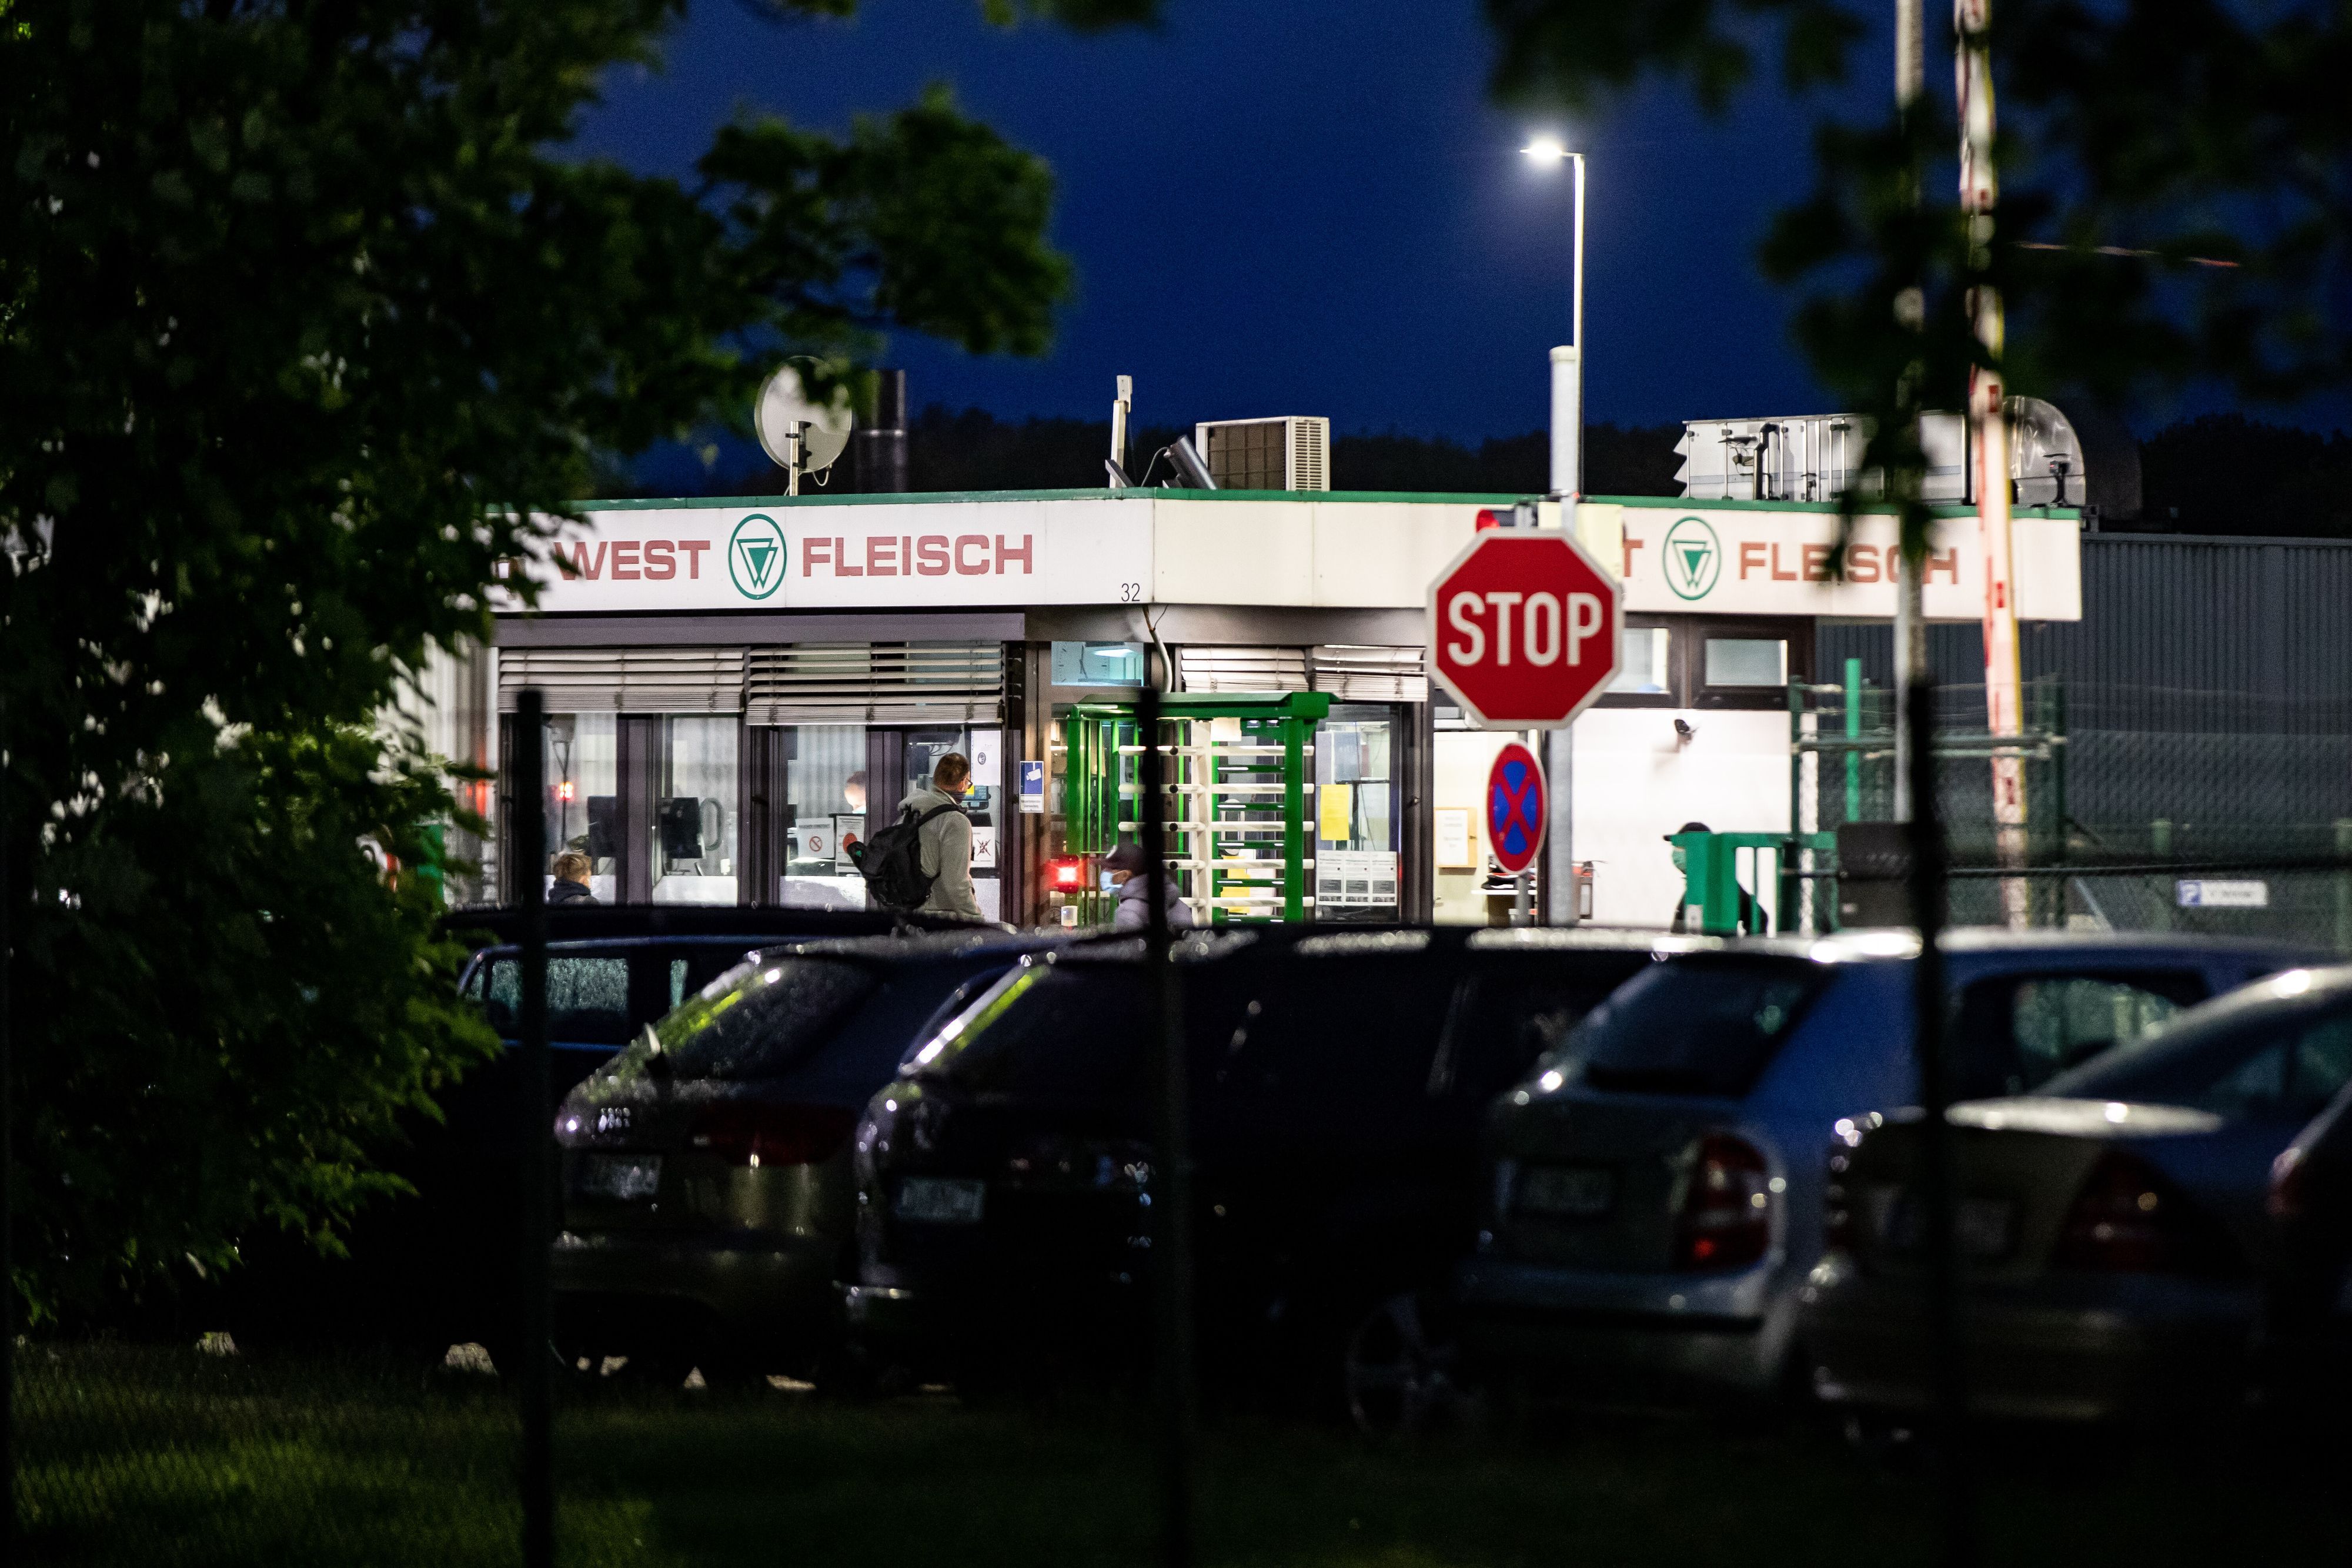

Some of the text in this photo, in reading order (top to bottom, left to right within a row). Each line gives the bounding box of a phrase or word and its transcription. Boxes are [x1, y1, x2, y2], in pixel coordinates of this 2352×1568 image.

[553, 534, 1033, 580] WEST FLEISCH
[1739, 541, 1959, 584] FLESH
[1121, 583, 1140, 602] 32
[1448, 591, 1603, 667] STOP
